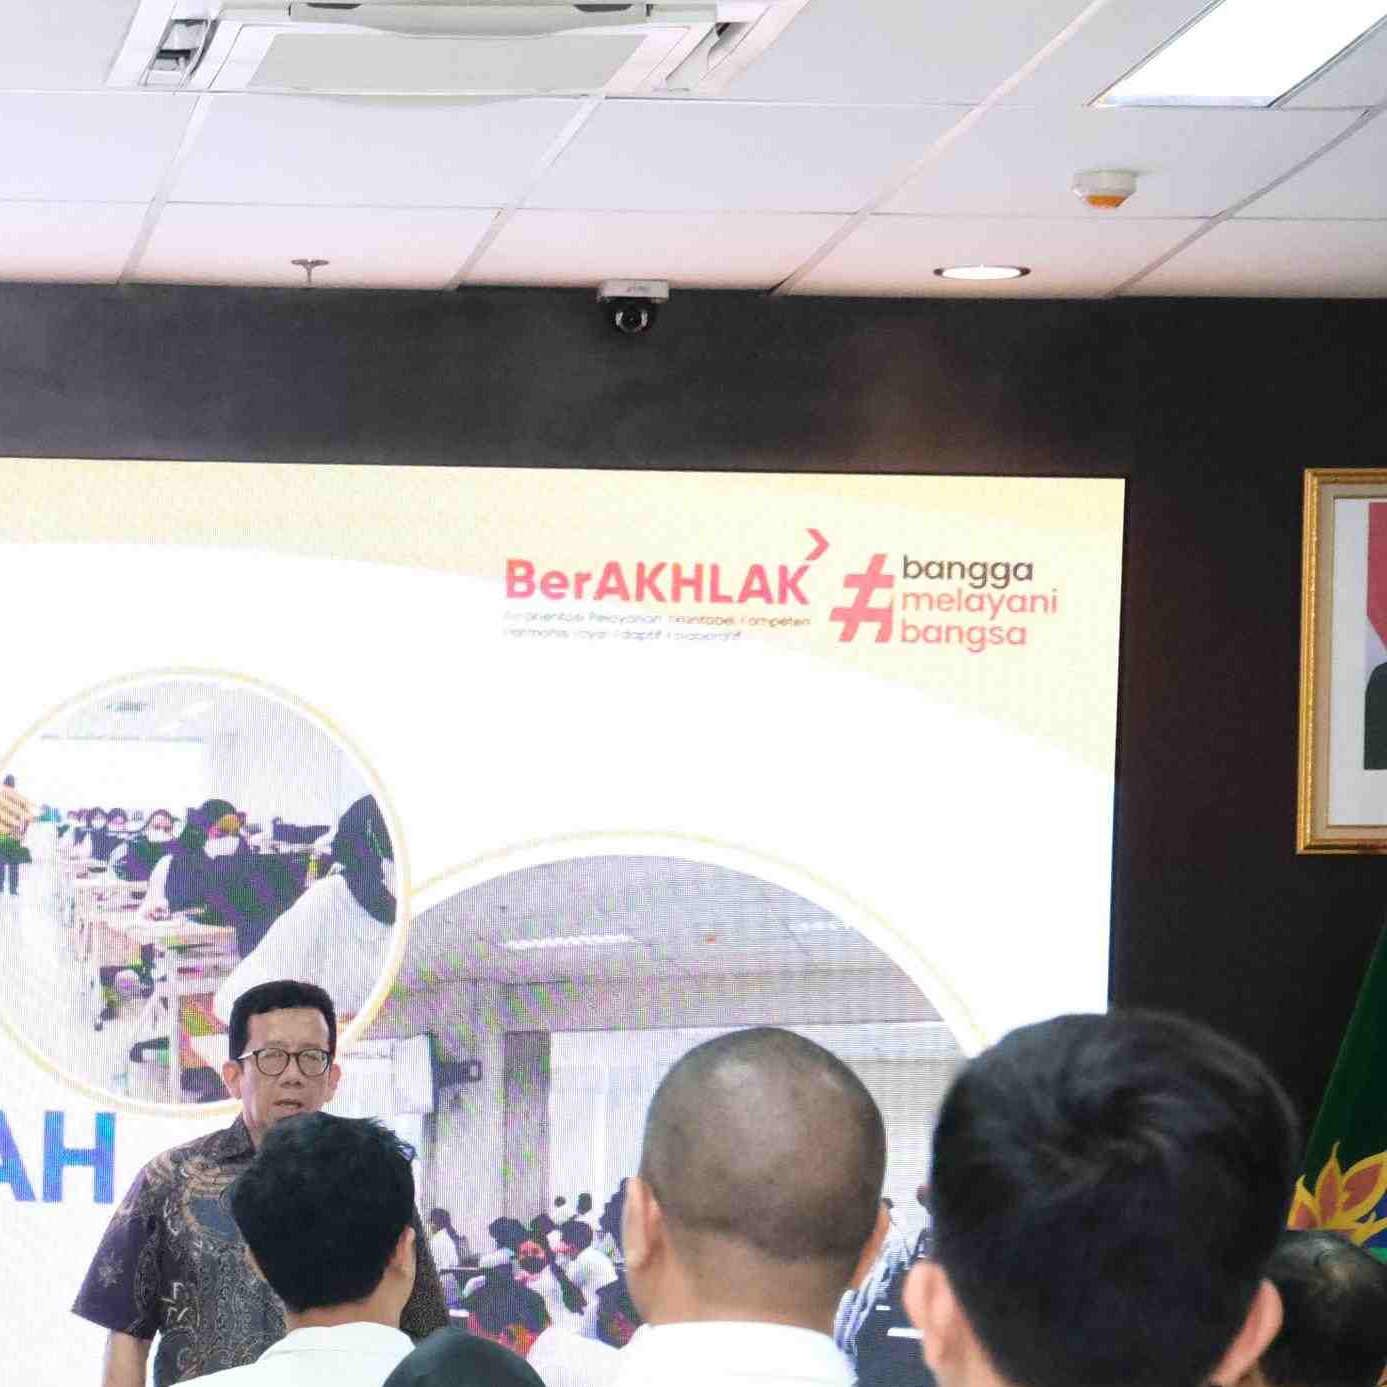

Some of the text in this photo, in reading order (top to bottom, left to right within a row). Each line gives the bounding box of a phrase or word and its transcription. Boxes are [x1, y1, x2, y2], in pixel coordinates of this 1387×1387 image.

[505, 558, 811, 605] BerAKHLAK
[902, 554, 1034, 589] bangga
[902, 587, 1059, 622] melayani
[901, 619, 1027, 652] bangsa
